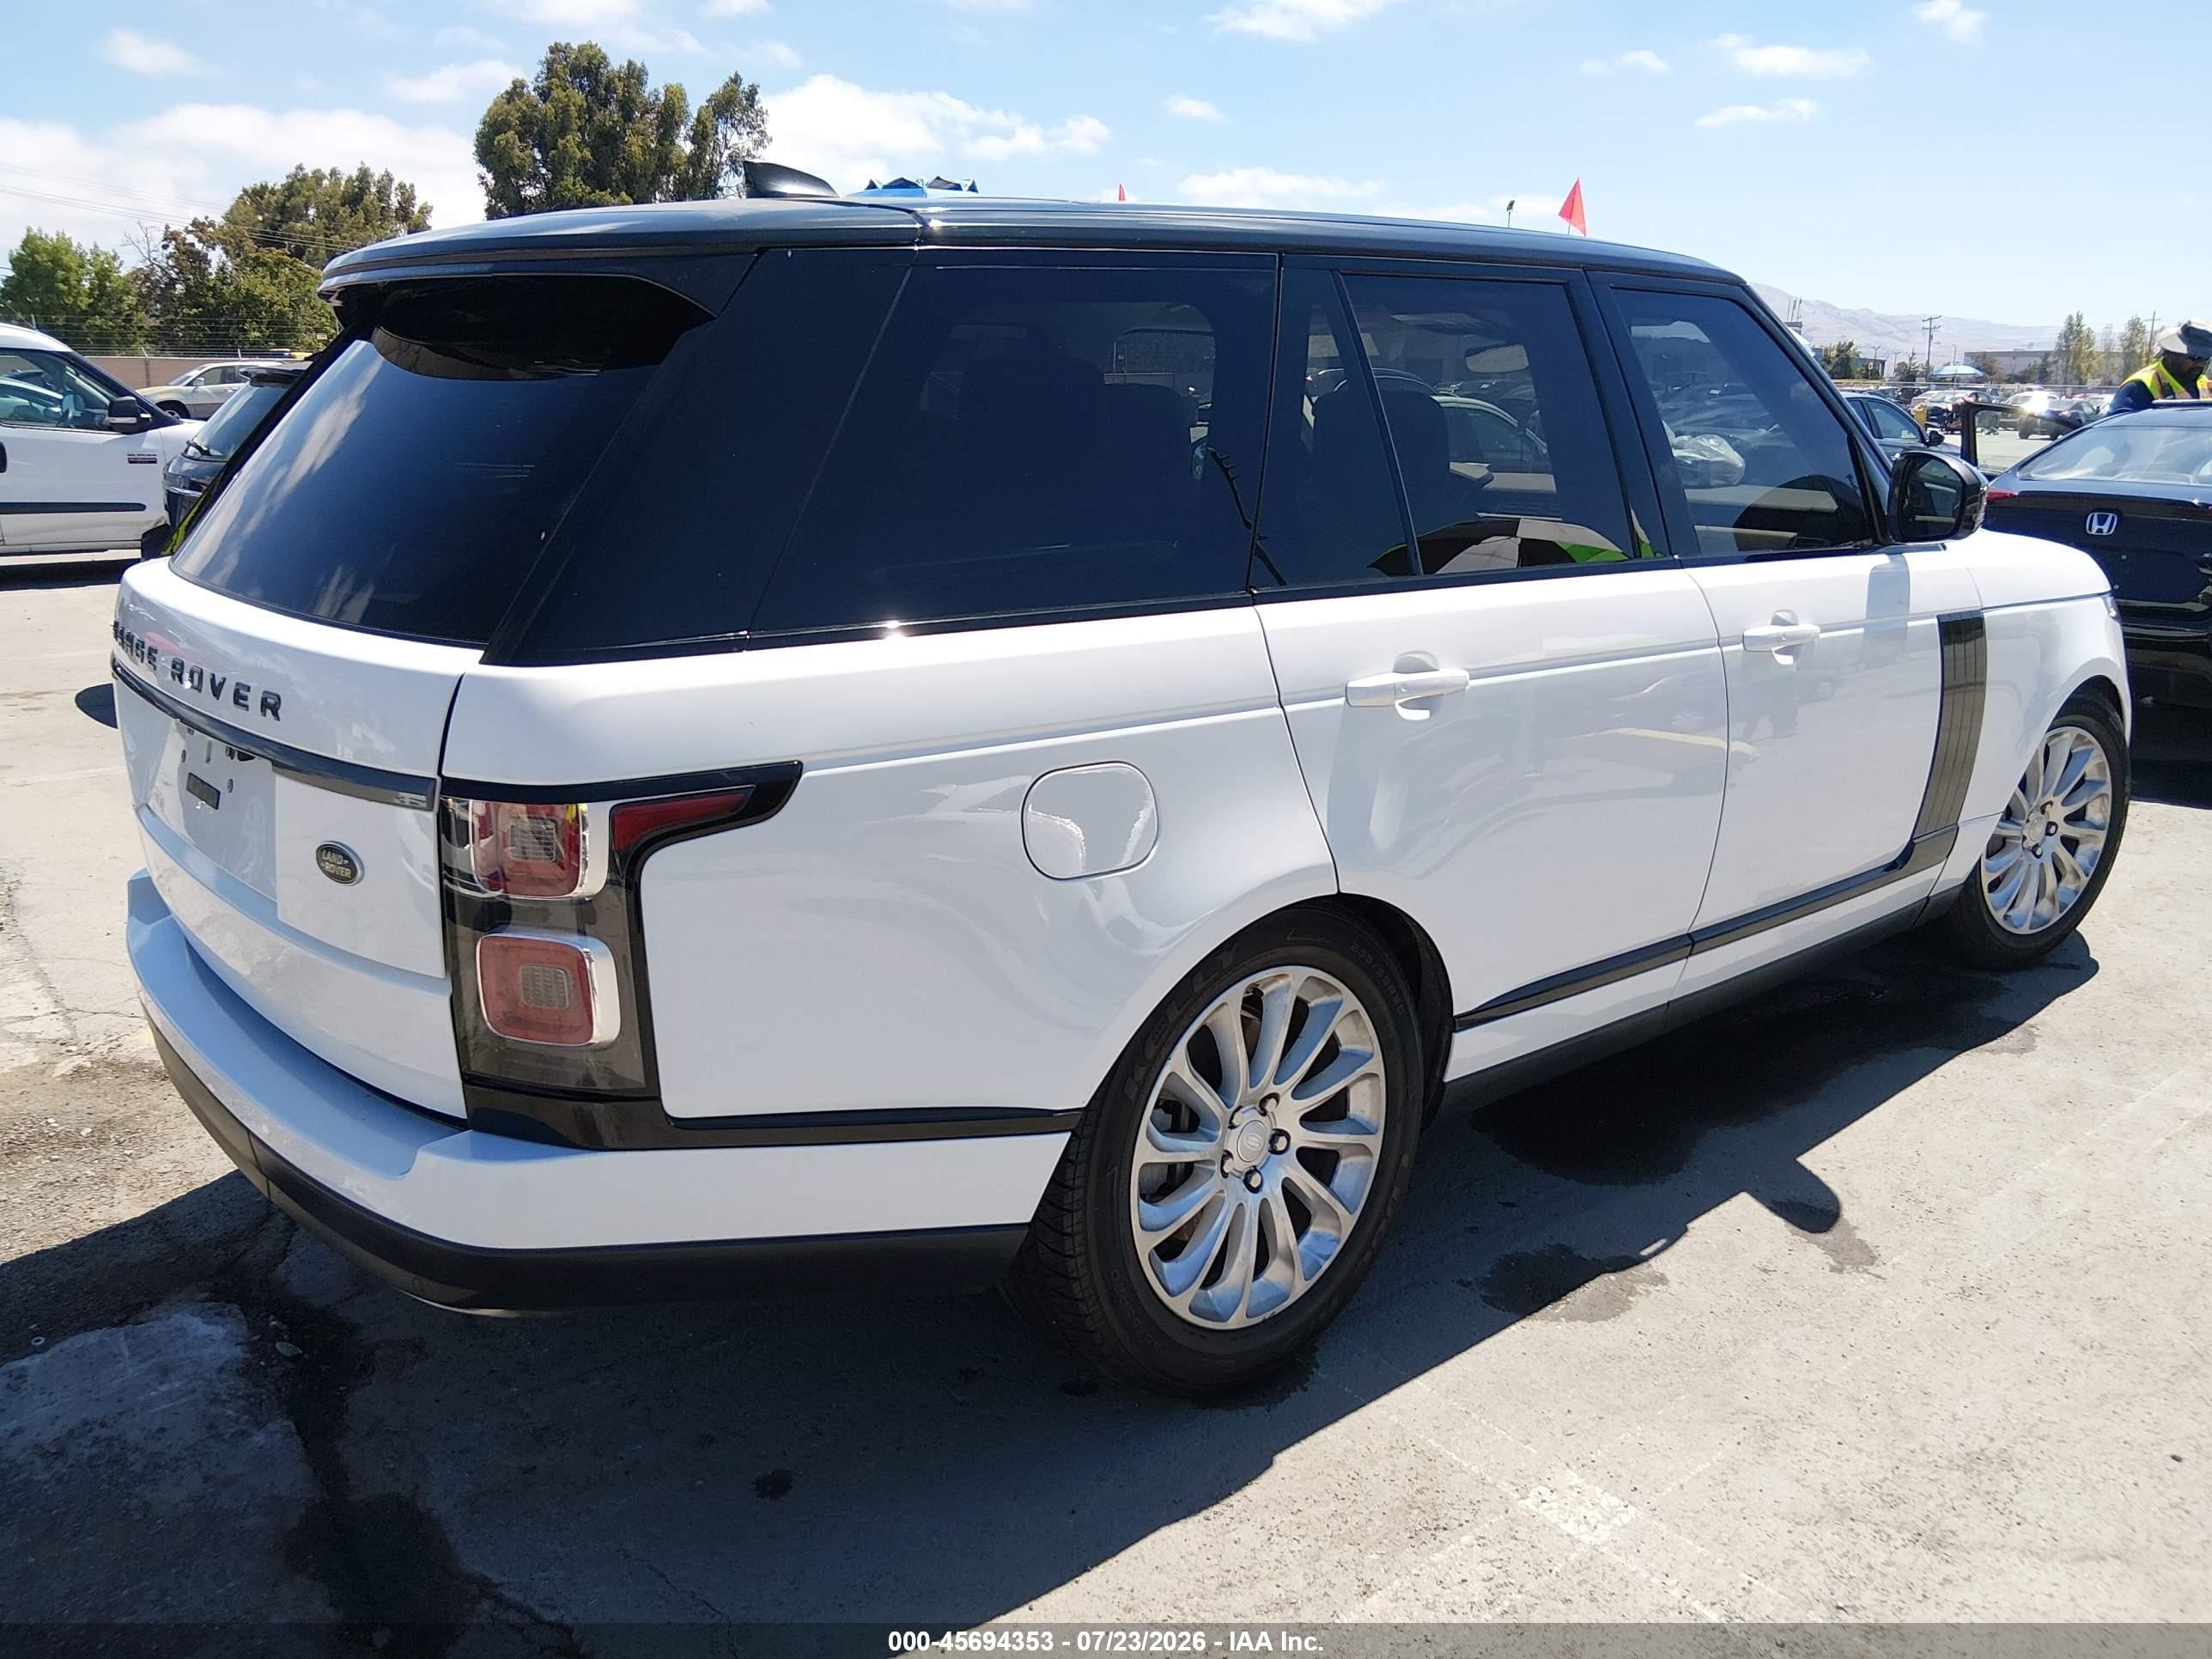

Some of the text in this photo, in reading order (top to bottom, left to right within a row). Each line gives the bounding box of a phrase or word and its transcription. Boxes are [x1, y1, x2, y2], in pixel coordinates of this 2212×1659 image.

[170, 657, 282, 721] ROVER
[321, 849, 344, 866] LAND
[324, 862, 351, 878] ROVER
